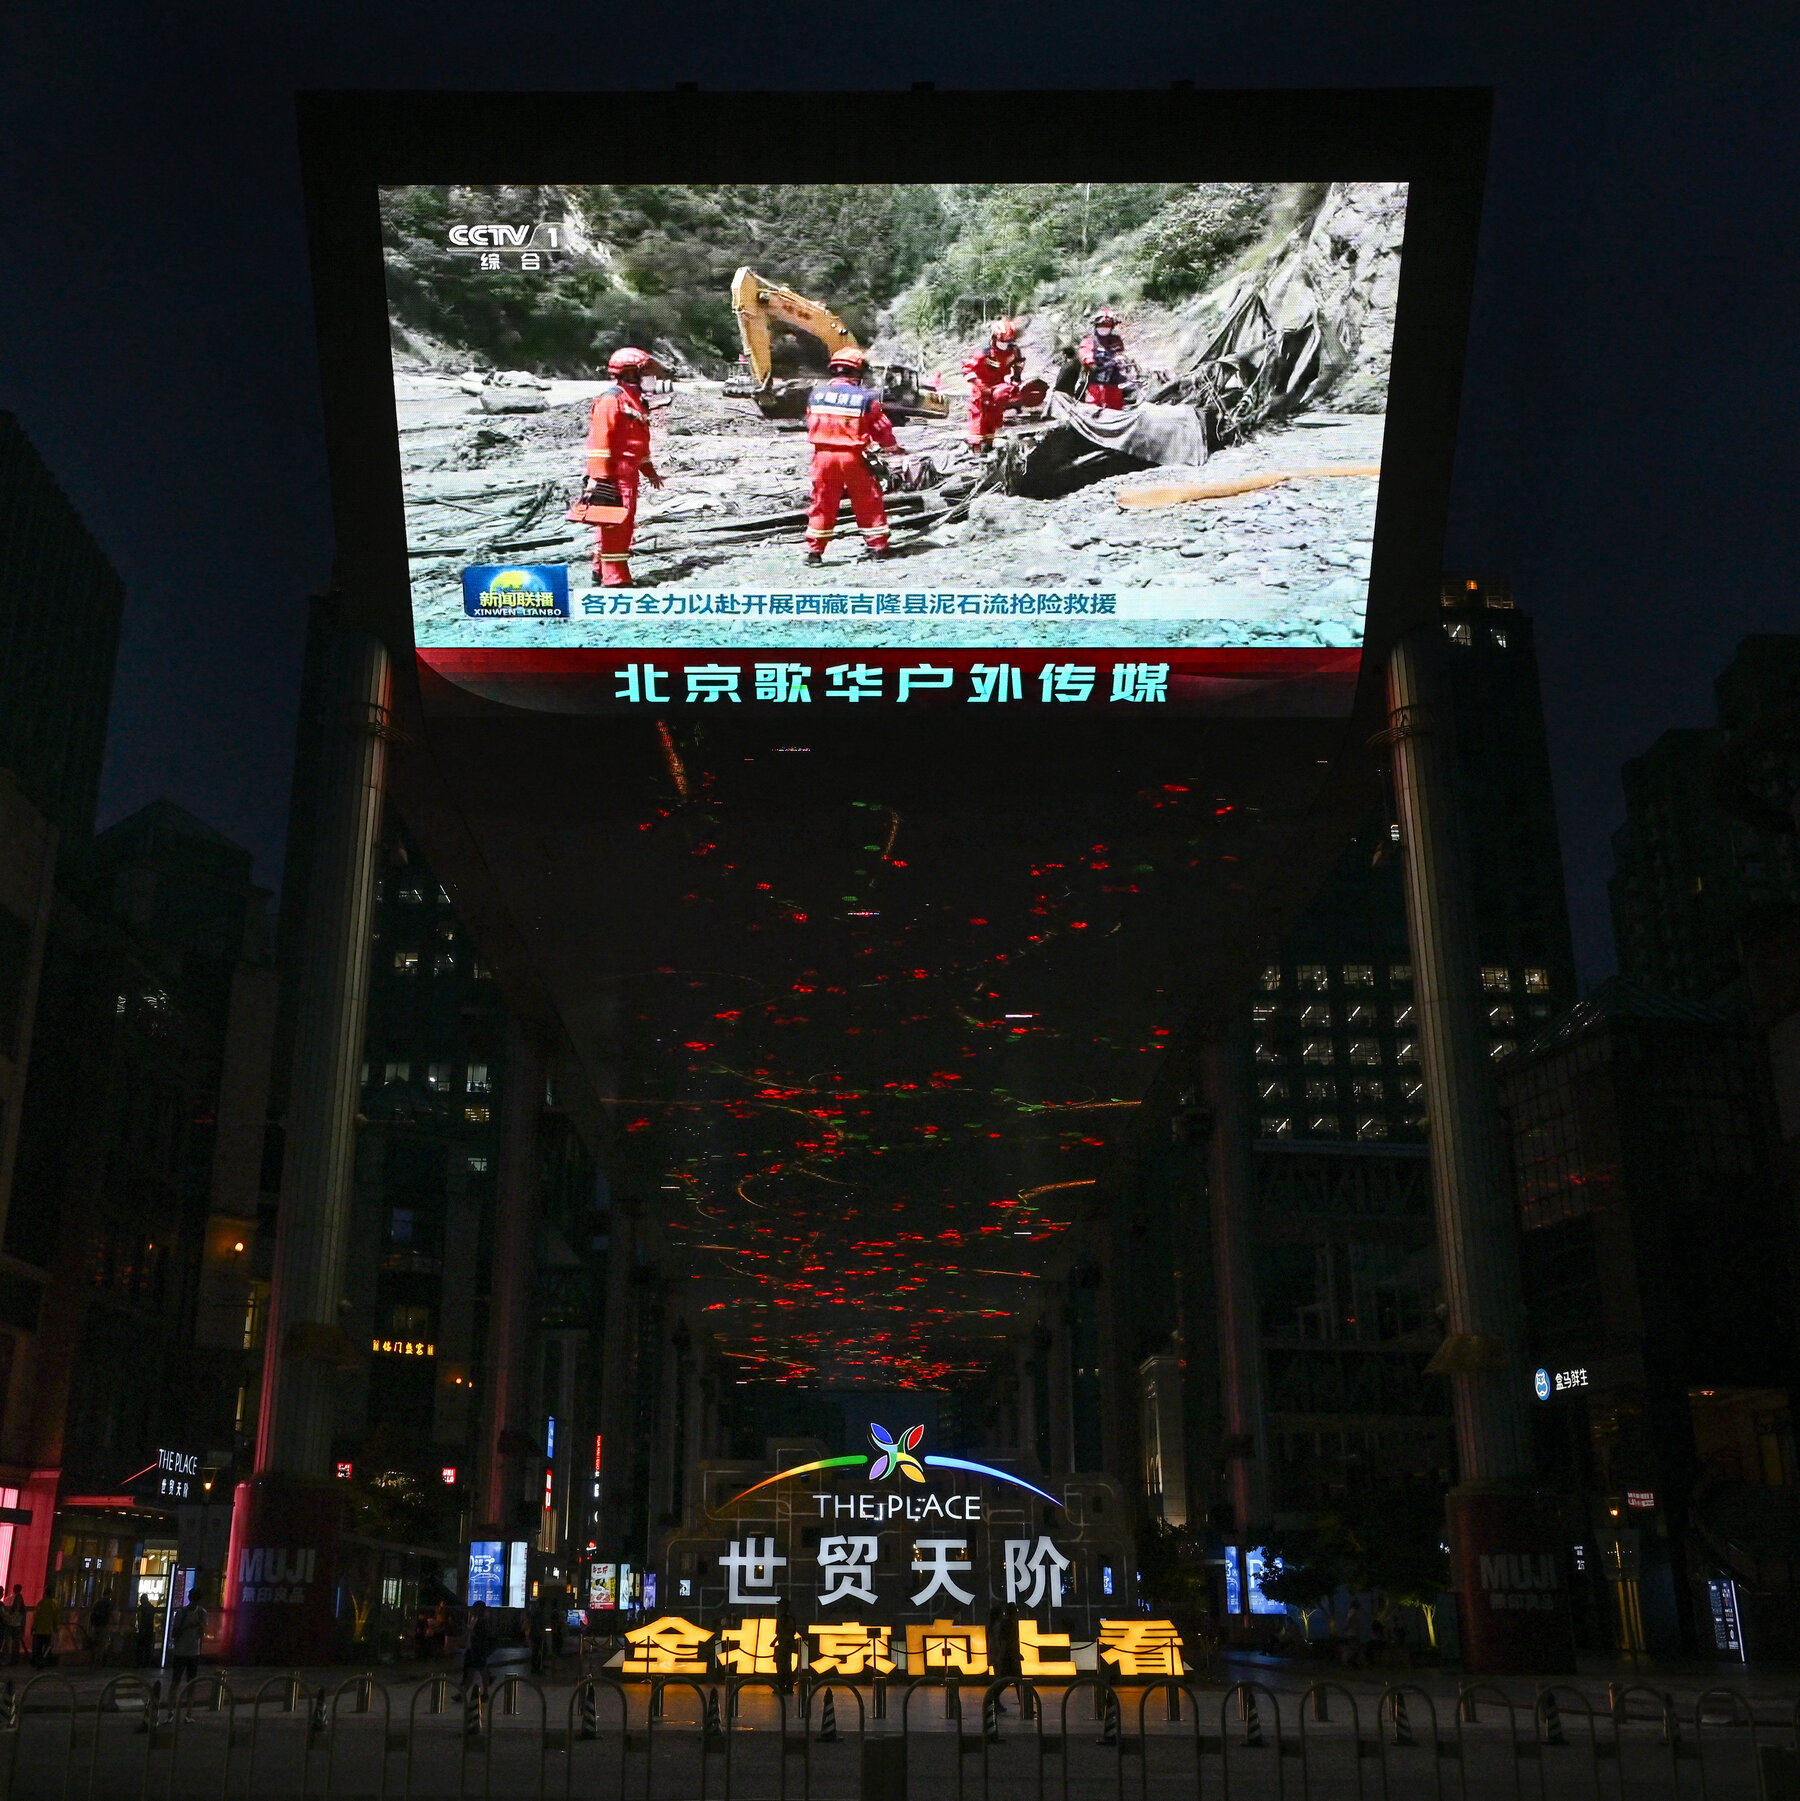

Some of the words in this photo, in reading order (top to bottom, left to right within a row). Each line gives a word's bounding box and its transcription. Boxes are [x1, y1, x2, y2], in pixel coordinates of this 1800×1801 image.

[448, 224, 530, 246] CCTV
[547, 227, 558, 248] 1
[480, 253, 540, 270] 综合
[473, 608, 517, 616] XINWEN
[522, 608, 562, 616] LIANBO
[479, 591, 554, 608] 新闻联播
[581, 593, 1117, 615] 各方全力以赴开展西藏吉隆县泥石流抢险救援
[614, 663, 1170, 703] 北京歌华户外传媒
[1555, 1368, 1588, 1390] 盒马鲜生
[159, 1449, 174, 1470] THE
[175, 1453, 197, 1475] PLACE
[813, 1495, 875, 1518] THE
[888, 1494, 981, 1520] PLACE
[239, 1548, 315, 1583] MUJI
[719, 1535, 1070, 1607] 世贸天阶
[1480, 1554, 1557, 1589] MUJI
[622, 1616, 1185, 1676] 全北京向上看
